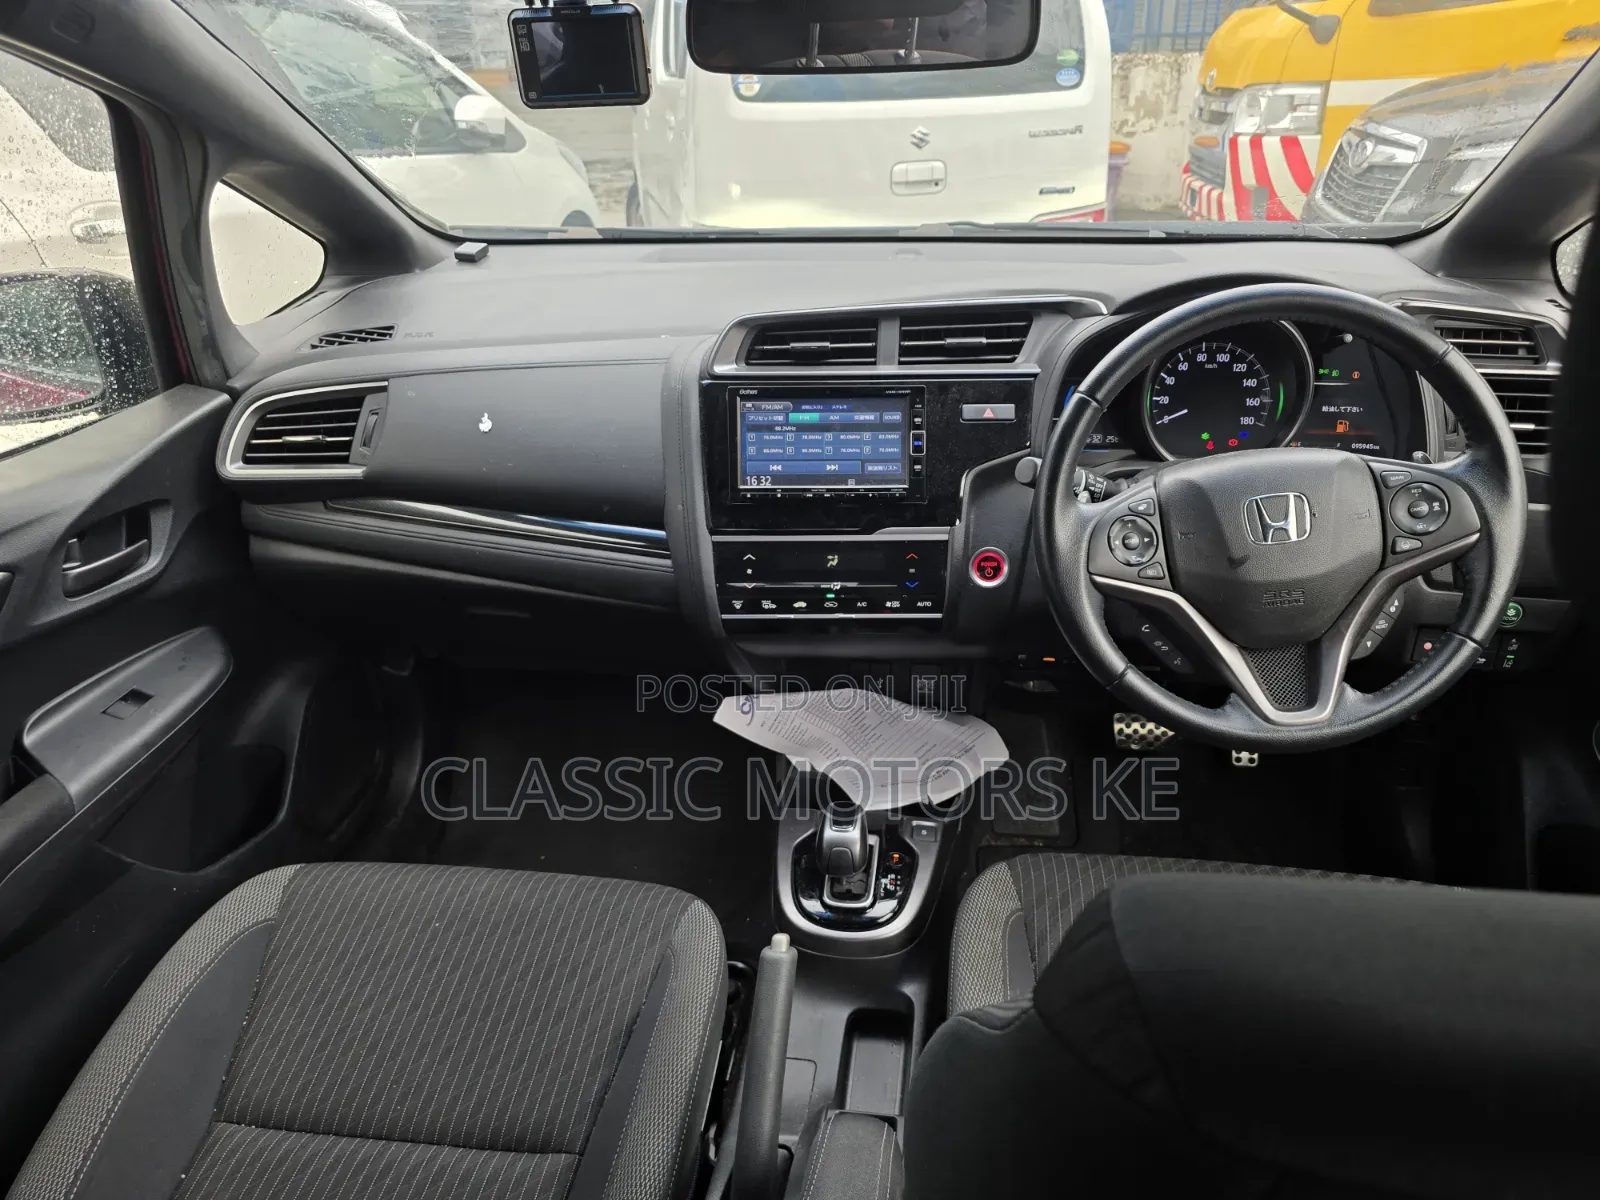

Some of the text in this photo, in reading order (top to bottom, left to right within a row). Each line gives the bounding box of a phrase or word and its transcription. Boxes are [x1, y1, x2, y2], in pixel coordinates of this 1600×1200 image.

[1197, 353, 1207, 362] 80
[1216, 353, 1230, 362] 100
[1178, 362, 1188, 371] 60
[1233, 363, 1247, 372] 120
[1165, 377, 1175, 385] 40
[1243, 379, 1257, 387] 140
[1159, 396, 1169, 404] 20
[1246, 398, 1260, 406] 160
[1240, 417, 1255, 425] 180
